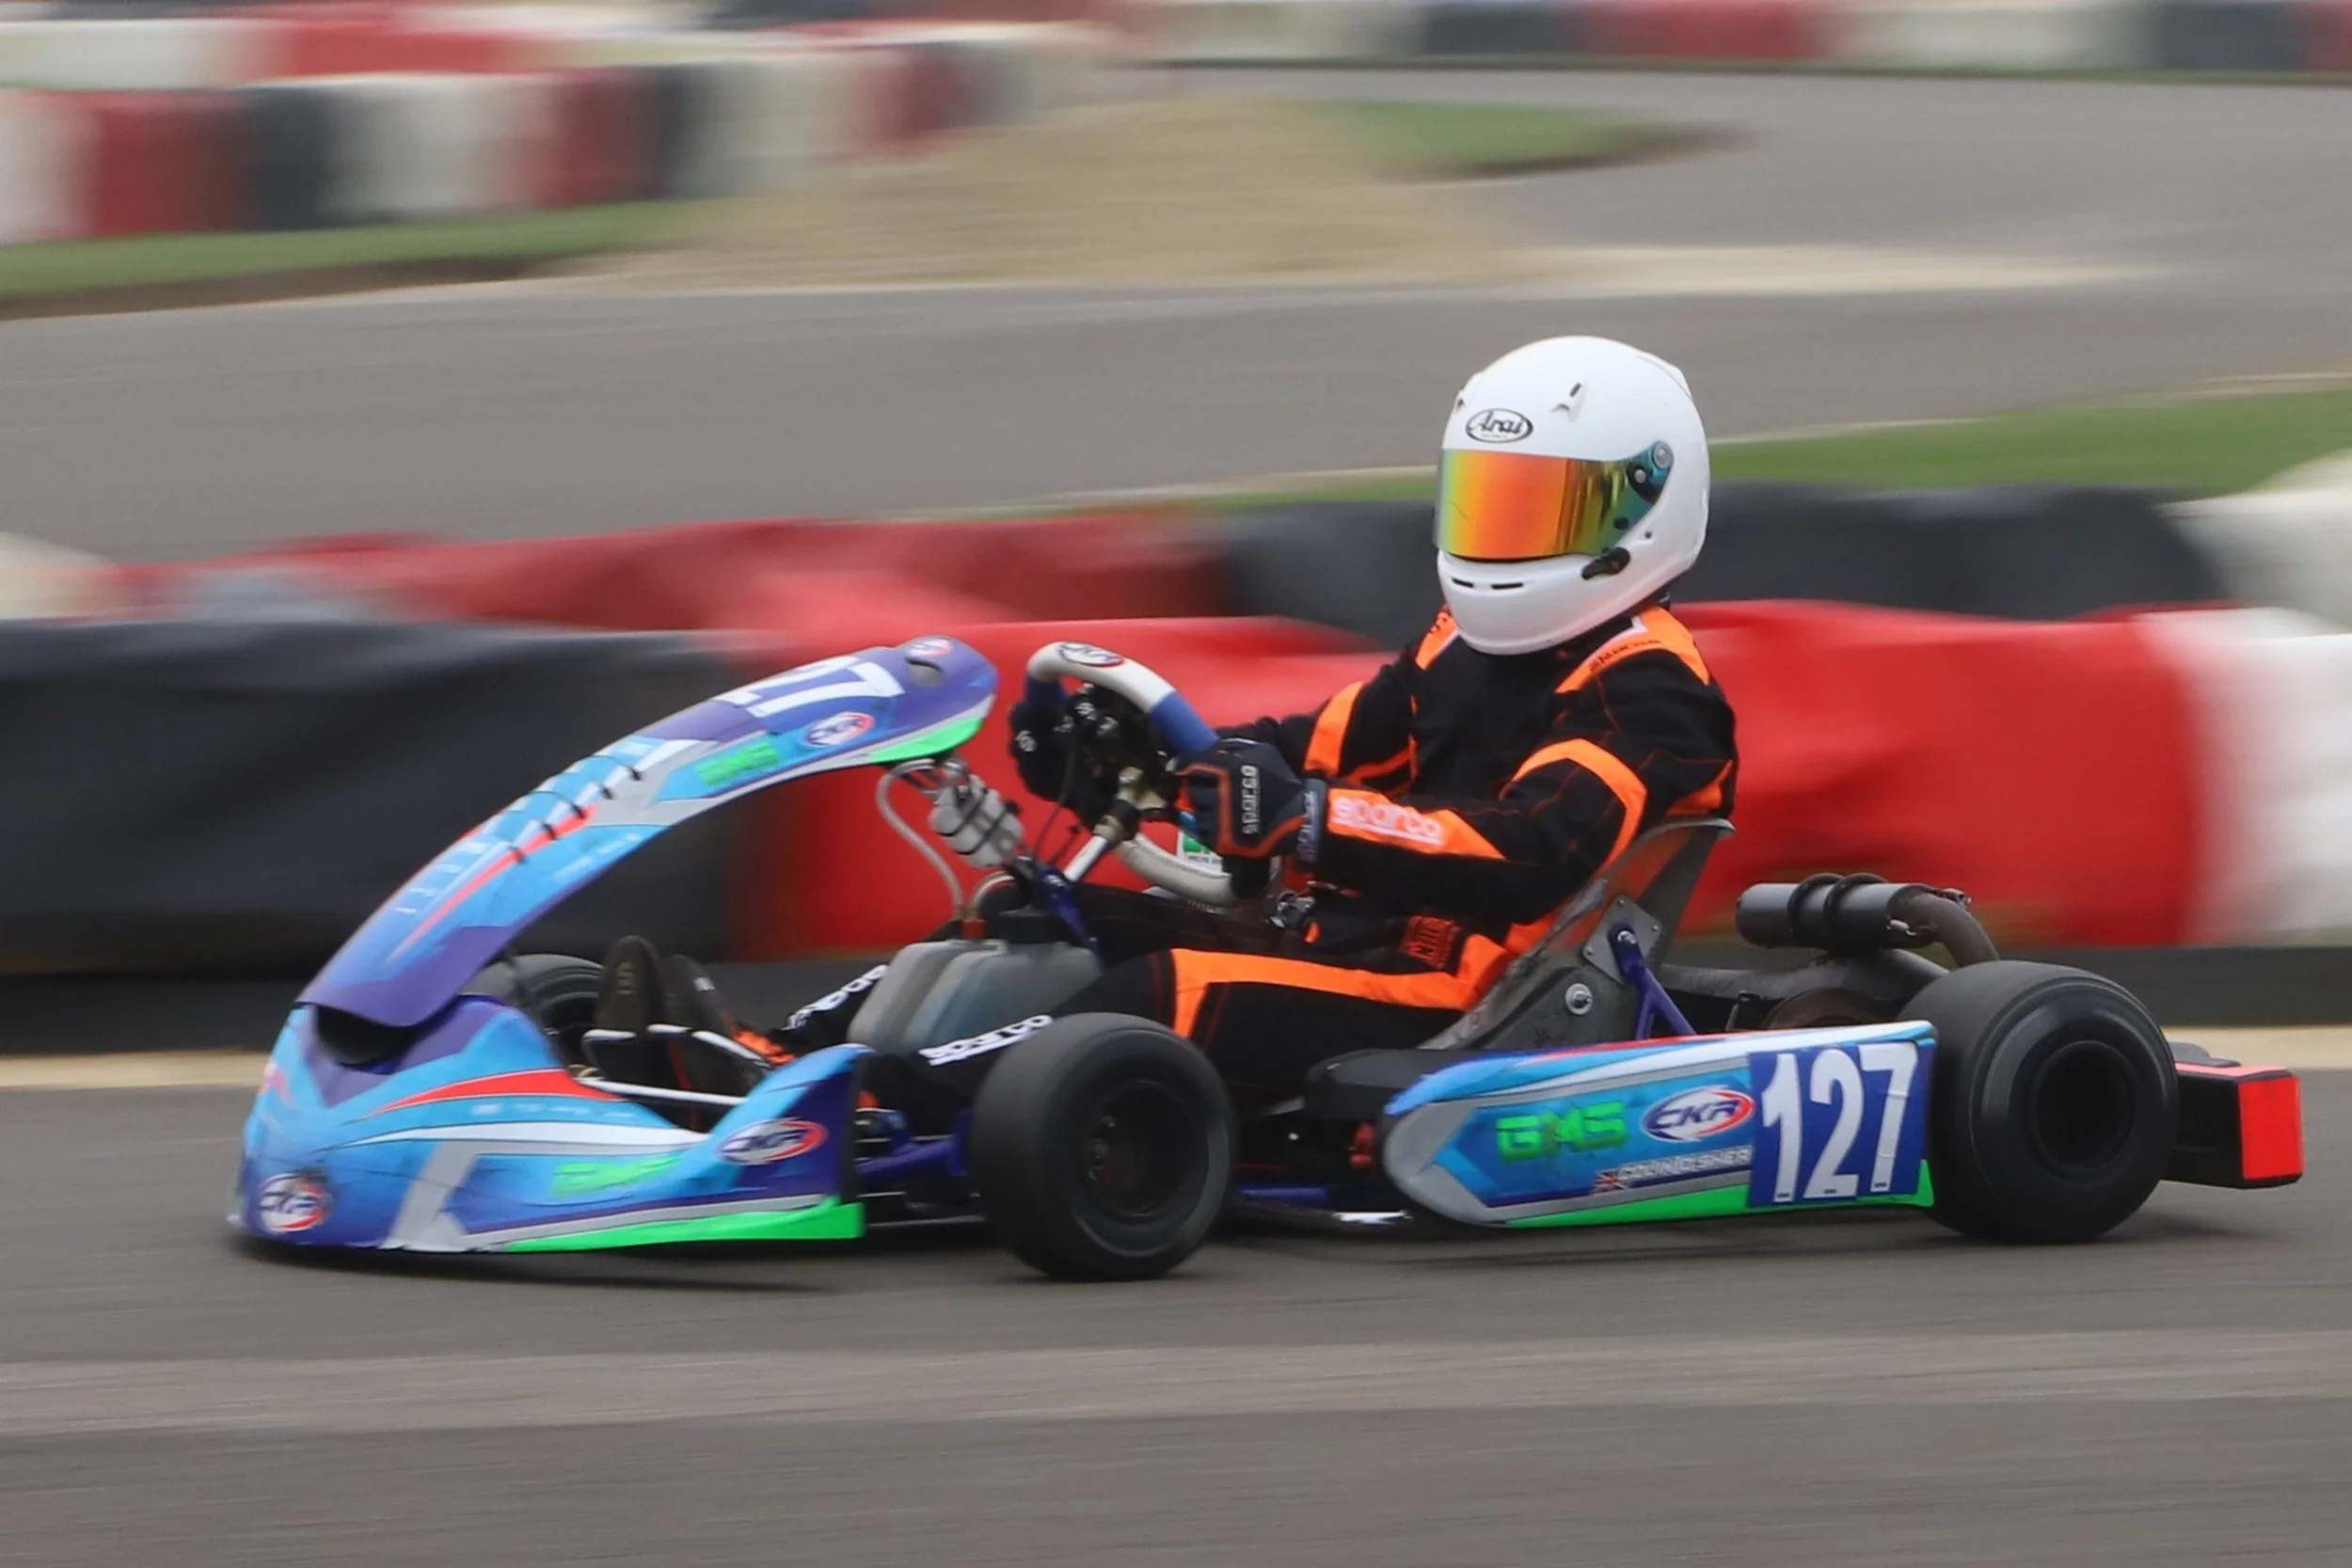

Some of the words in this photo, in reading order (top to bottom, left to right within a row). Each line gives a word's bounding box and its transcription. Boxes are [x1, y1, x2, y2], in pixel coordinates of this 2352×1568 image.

[1240, 765, 1262, 835] sparco
[1332, 797, 1443, 843] sparco
[1761, 1041, 1919, 1202] 127
